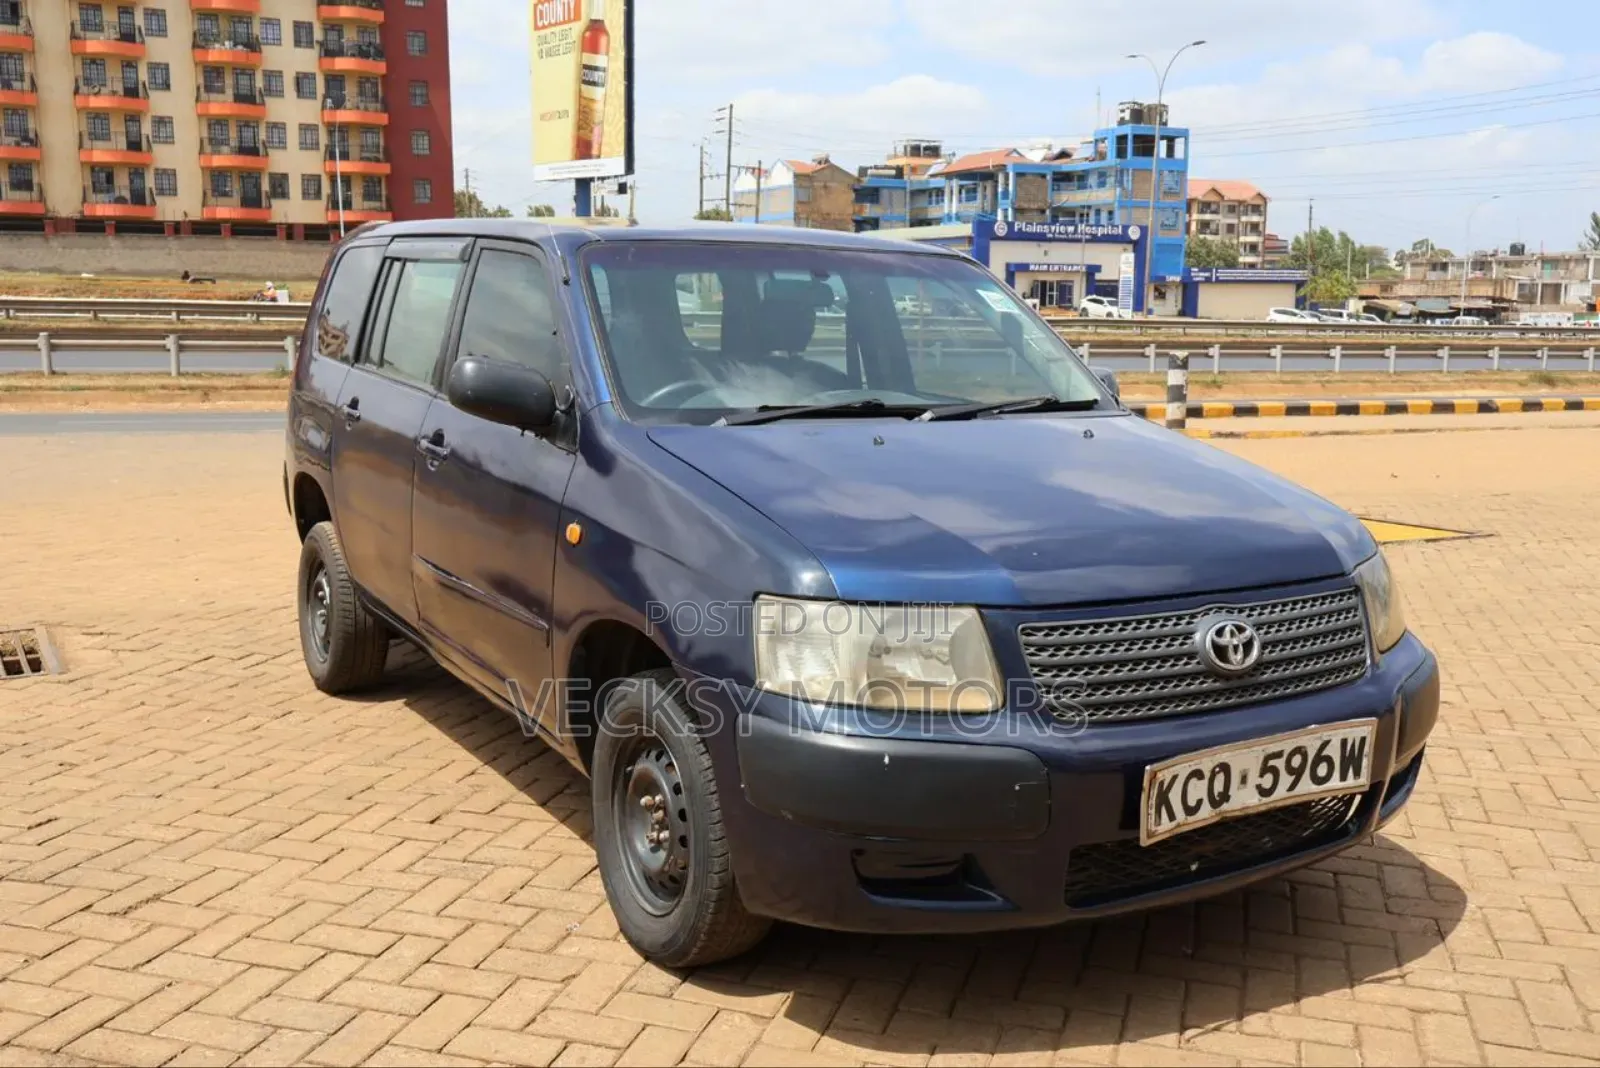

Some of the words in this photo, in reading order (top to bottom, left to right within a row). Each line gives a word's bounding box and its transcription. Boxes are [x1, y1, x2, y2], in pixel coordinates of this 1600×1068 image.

[537, 0, 576, 27] COUNTY
[558, 28, 573, 42] LEGIT
[1014, 221, 1075, 234] Plainsview
[1078, 224, 1123, 236] Hospital
[1049, 264, 1087, 272] ENTRANCE
[1154, 762, 1231, 827] KCQ
[1255, 736, 1367, 798] 596W
